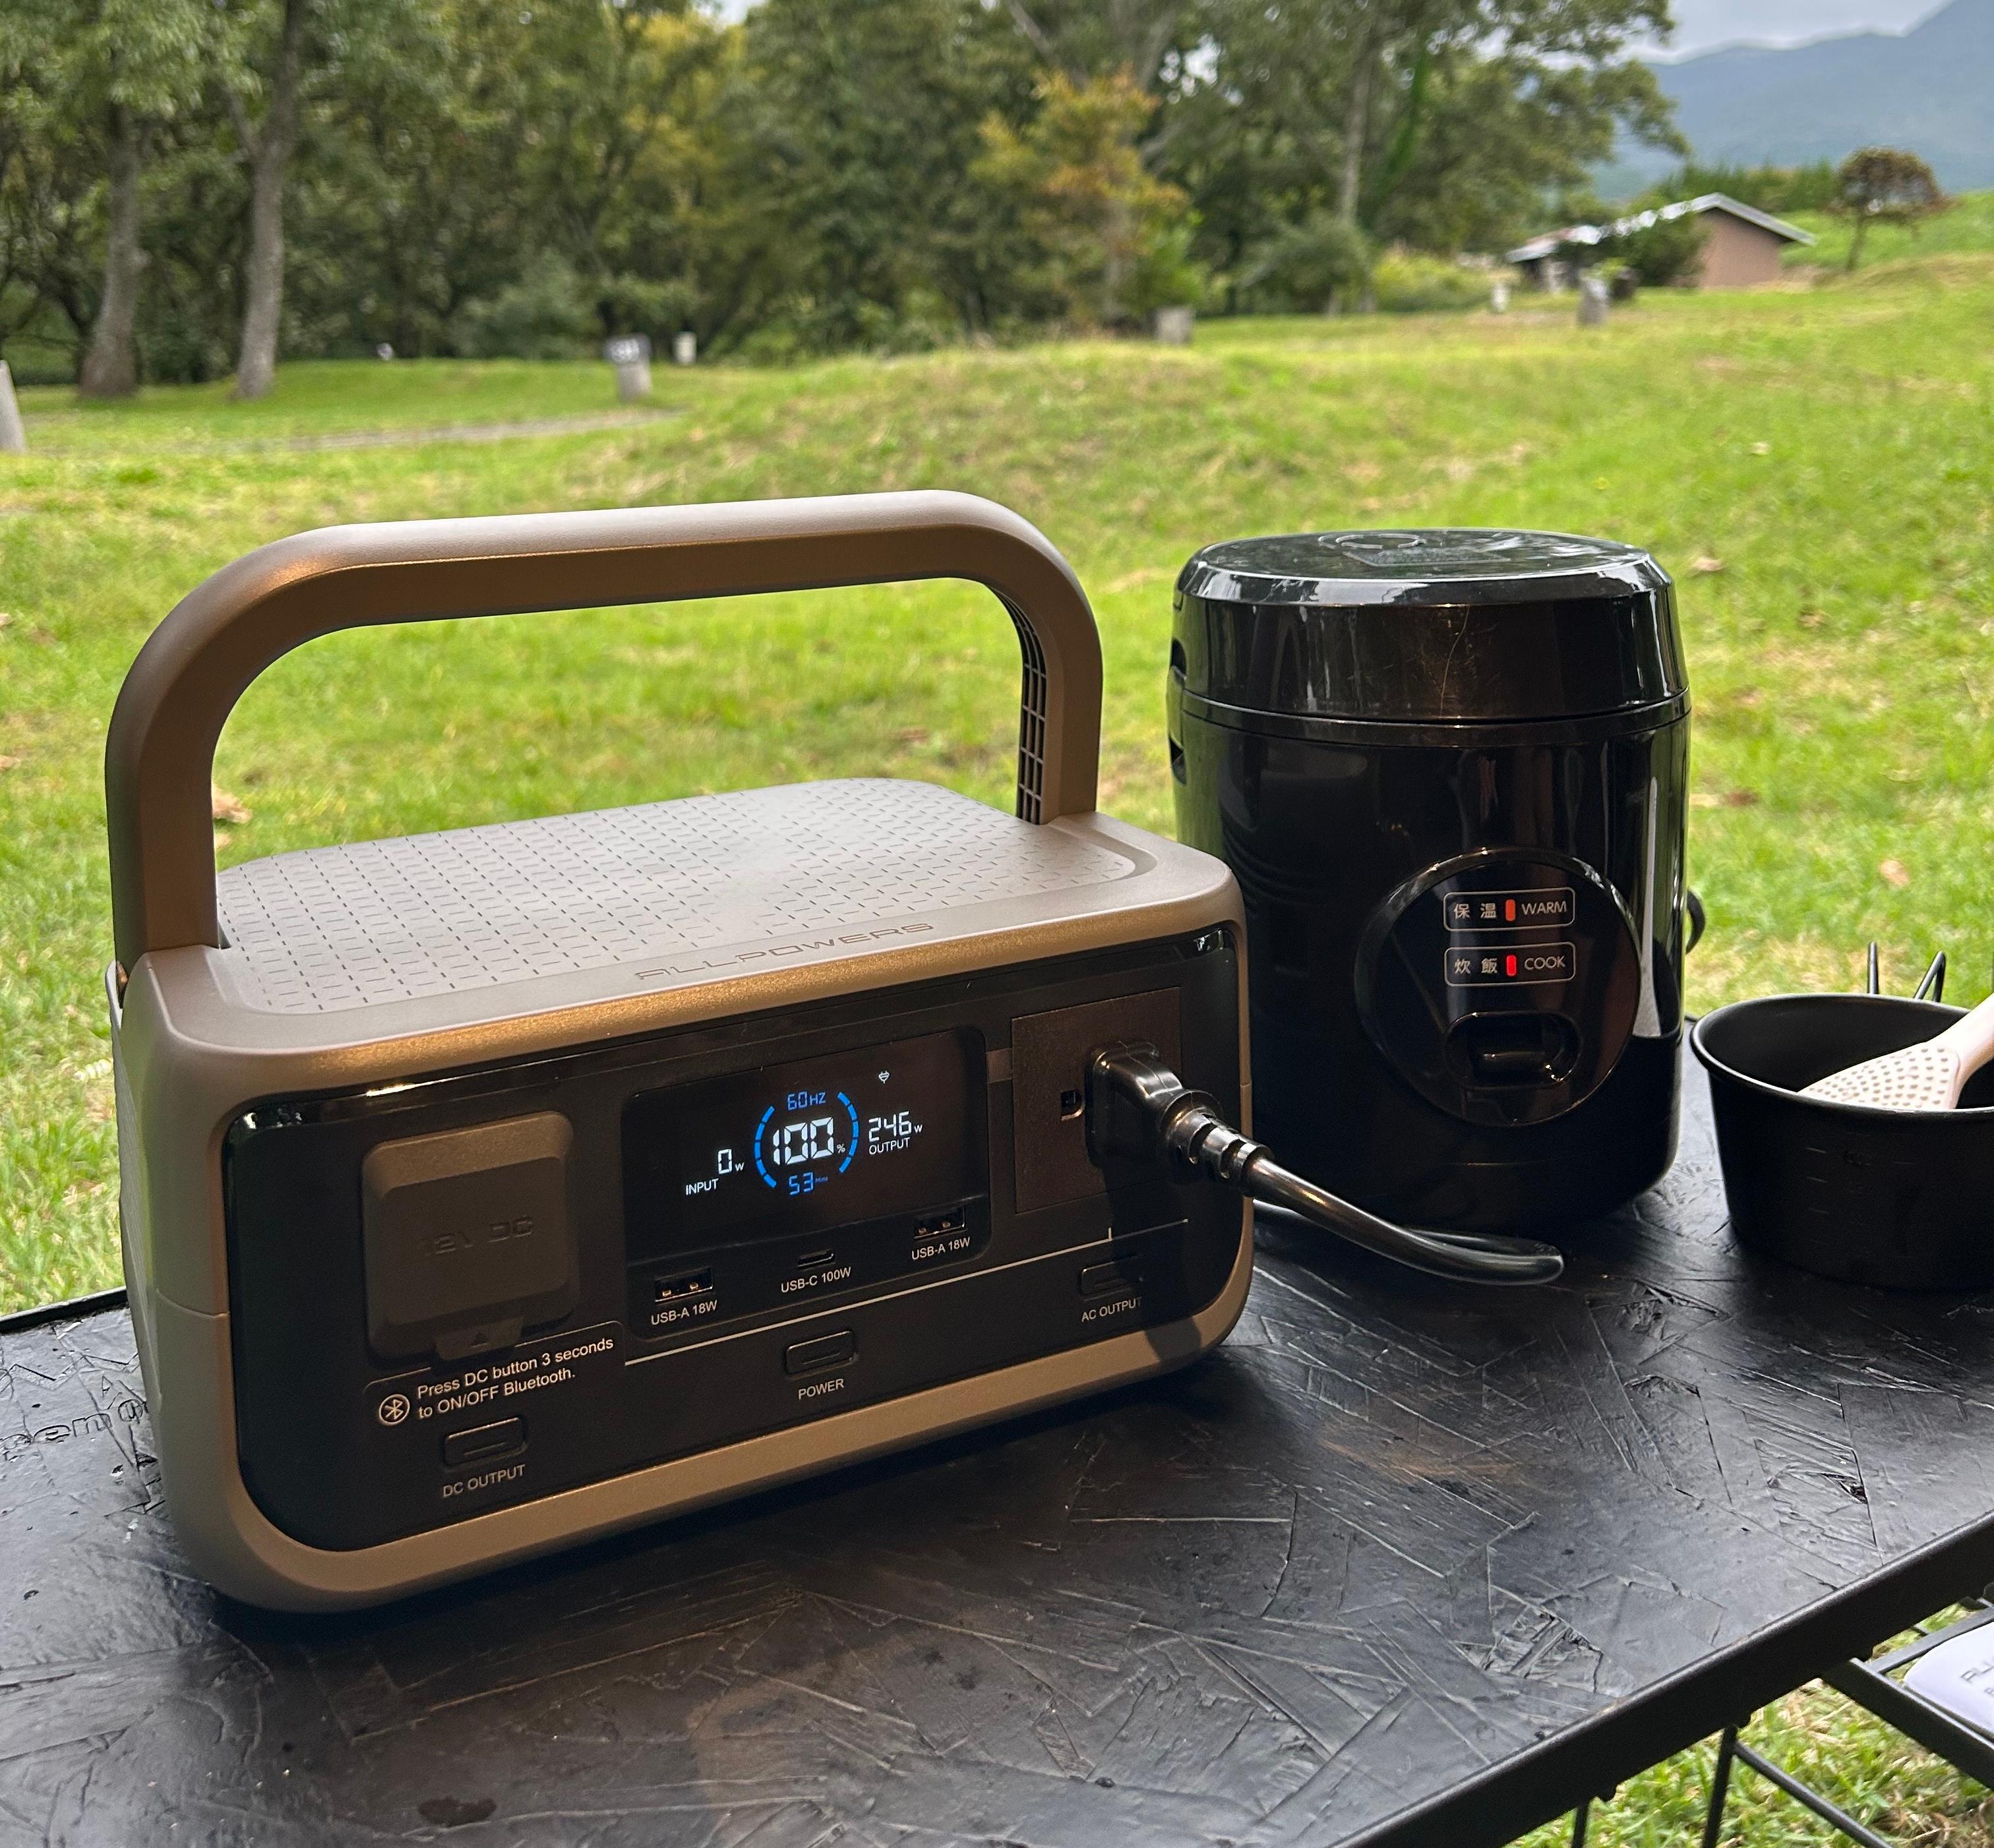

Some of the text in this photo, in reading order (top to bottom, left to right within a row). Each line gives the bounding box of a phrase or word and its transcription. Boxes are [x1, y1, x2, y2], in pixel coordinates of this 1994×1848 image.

[1521, 901, 1567, 915] WARM
[634, 923, 934, 980] ALLPOWERS
[1524, 955, 1566, 970] COOK
[868, 1137, 911, 1154] OUTPUT
[686, 1177, 719, 1196] INPUT
[911, 1236, 971, 1260] USB-A 18W
[781, 1267, 851, 1293] USB-C 100W
[651, 1299, 717, 1325] USB-A 18W
[1081, 1297, 1142, 1323] AC OUTPUT
[417, 1338, 614, 1399] Press DC button 3 seconds
[419, 1367, 576, 1419] to ON/OFF Bluetooth.
[798, 1378, 844, 1400] POWER
[443, 1464, 526, 1498] DC OUTPUT
